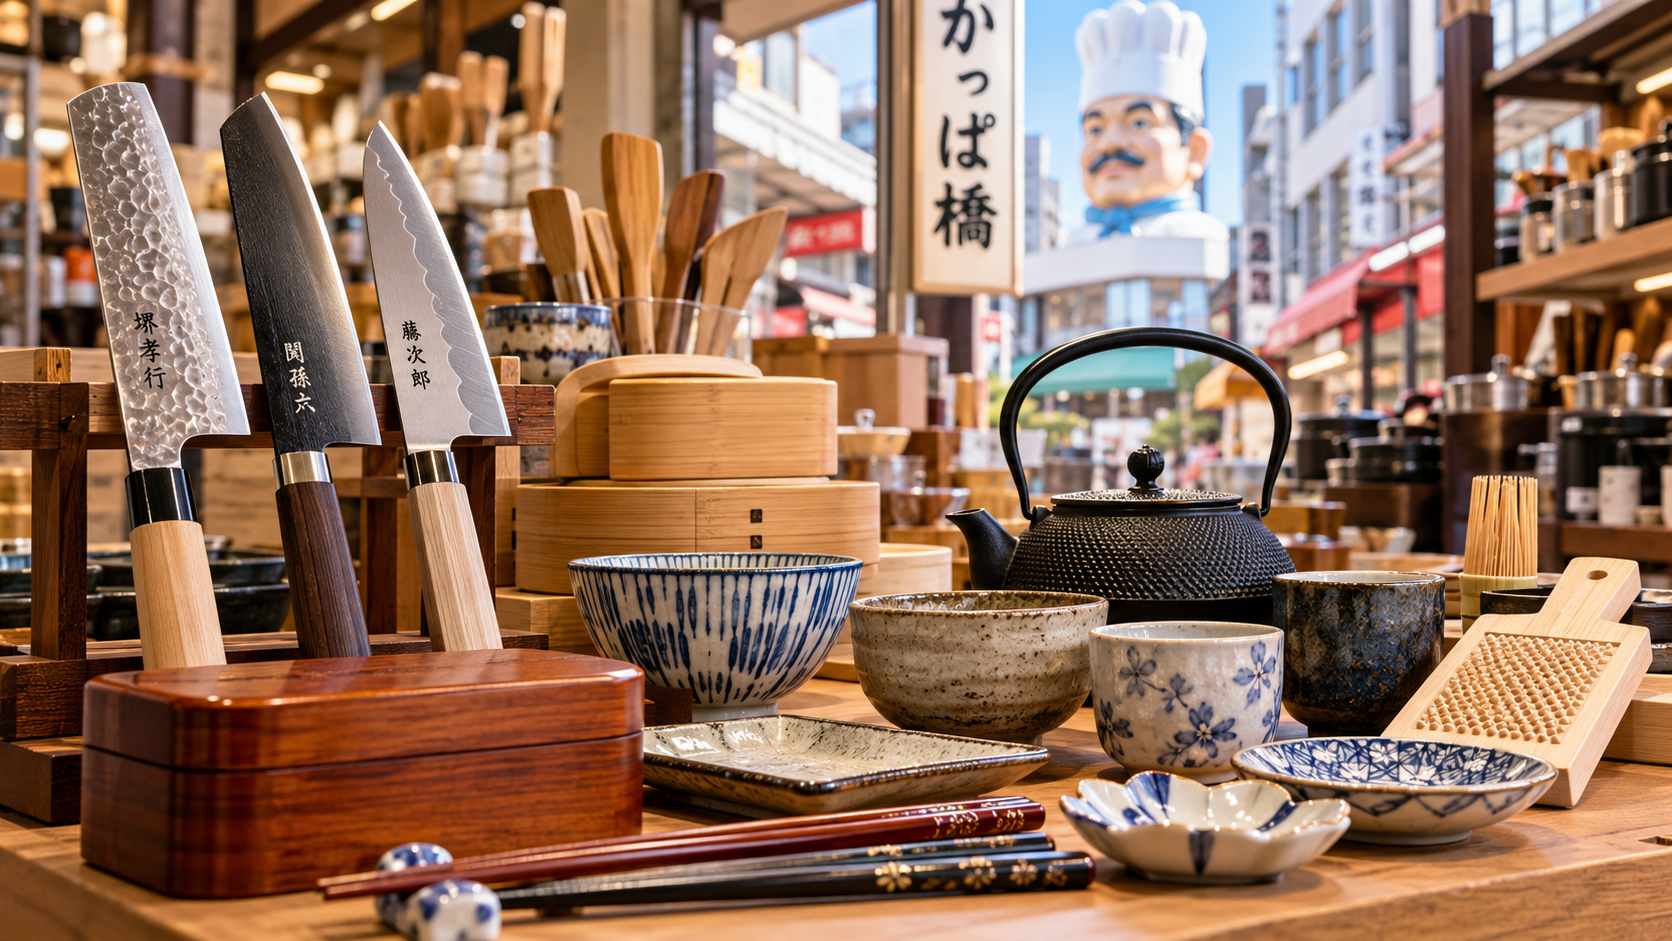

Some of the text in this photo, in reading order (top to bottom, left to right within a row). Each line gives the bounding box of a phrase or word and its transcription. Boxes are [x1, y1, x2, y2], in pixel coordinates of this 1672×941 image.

[934, 0, 997, 249] かっぱ橋
[133, 311, 166, 389] 堺孝行
[401, 320, 431, 390] 藤次郎
